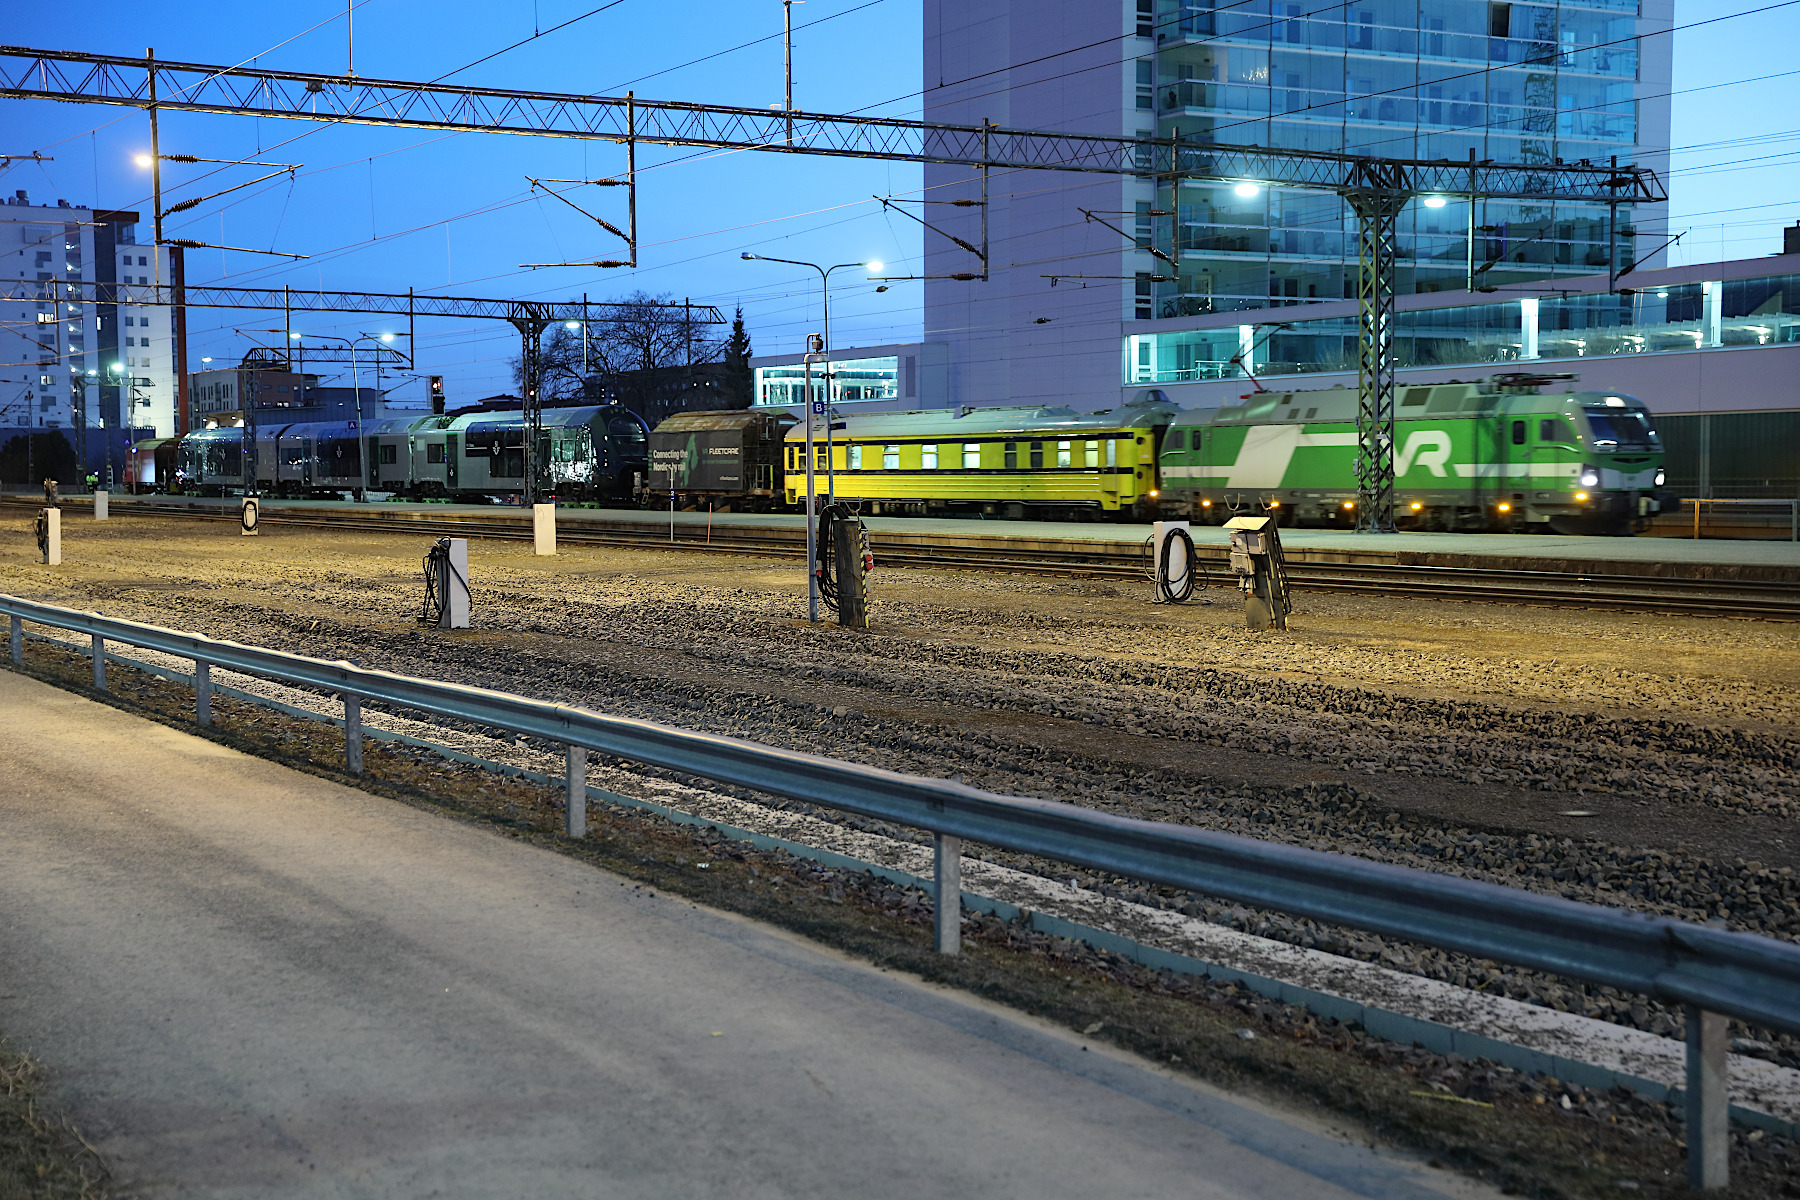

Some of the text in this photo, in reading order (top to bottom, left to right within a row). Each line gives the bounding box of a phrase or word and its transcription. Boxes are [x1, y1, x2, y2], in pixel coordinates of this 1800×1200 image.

[815, 403, 823, 412] B
[653, 449, 688, 460] Connecting the
[1380, 430, 1451, 478] VR
[653, 462, 671, 471] Nordics
